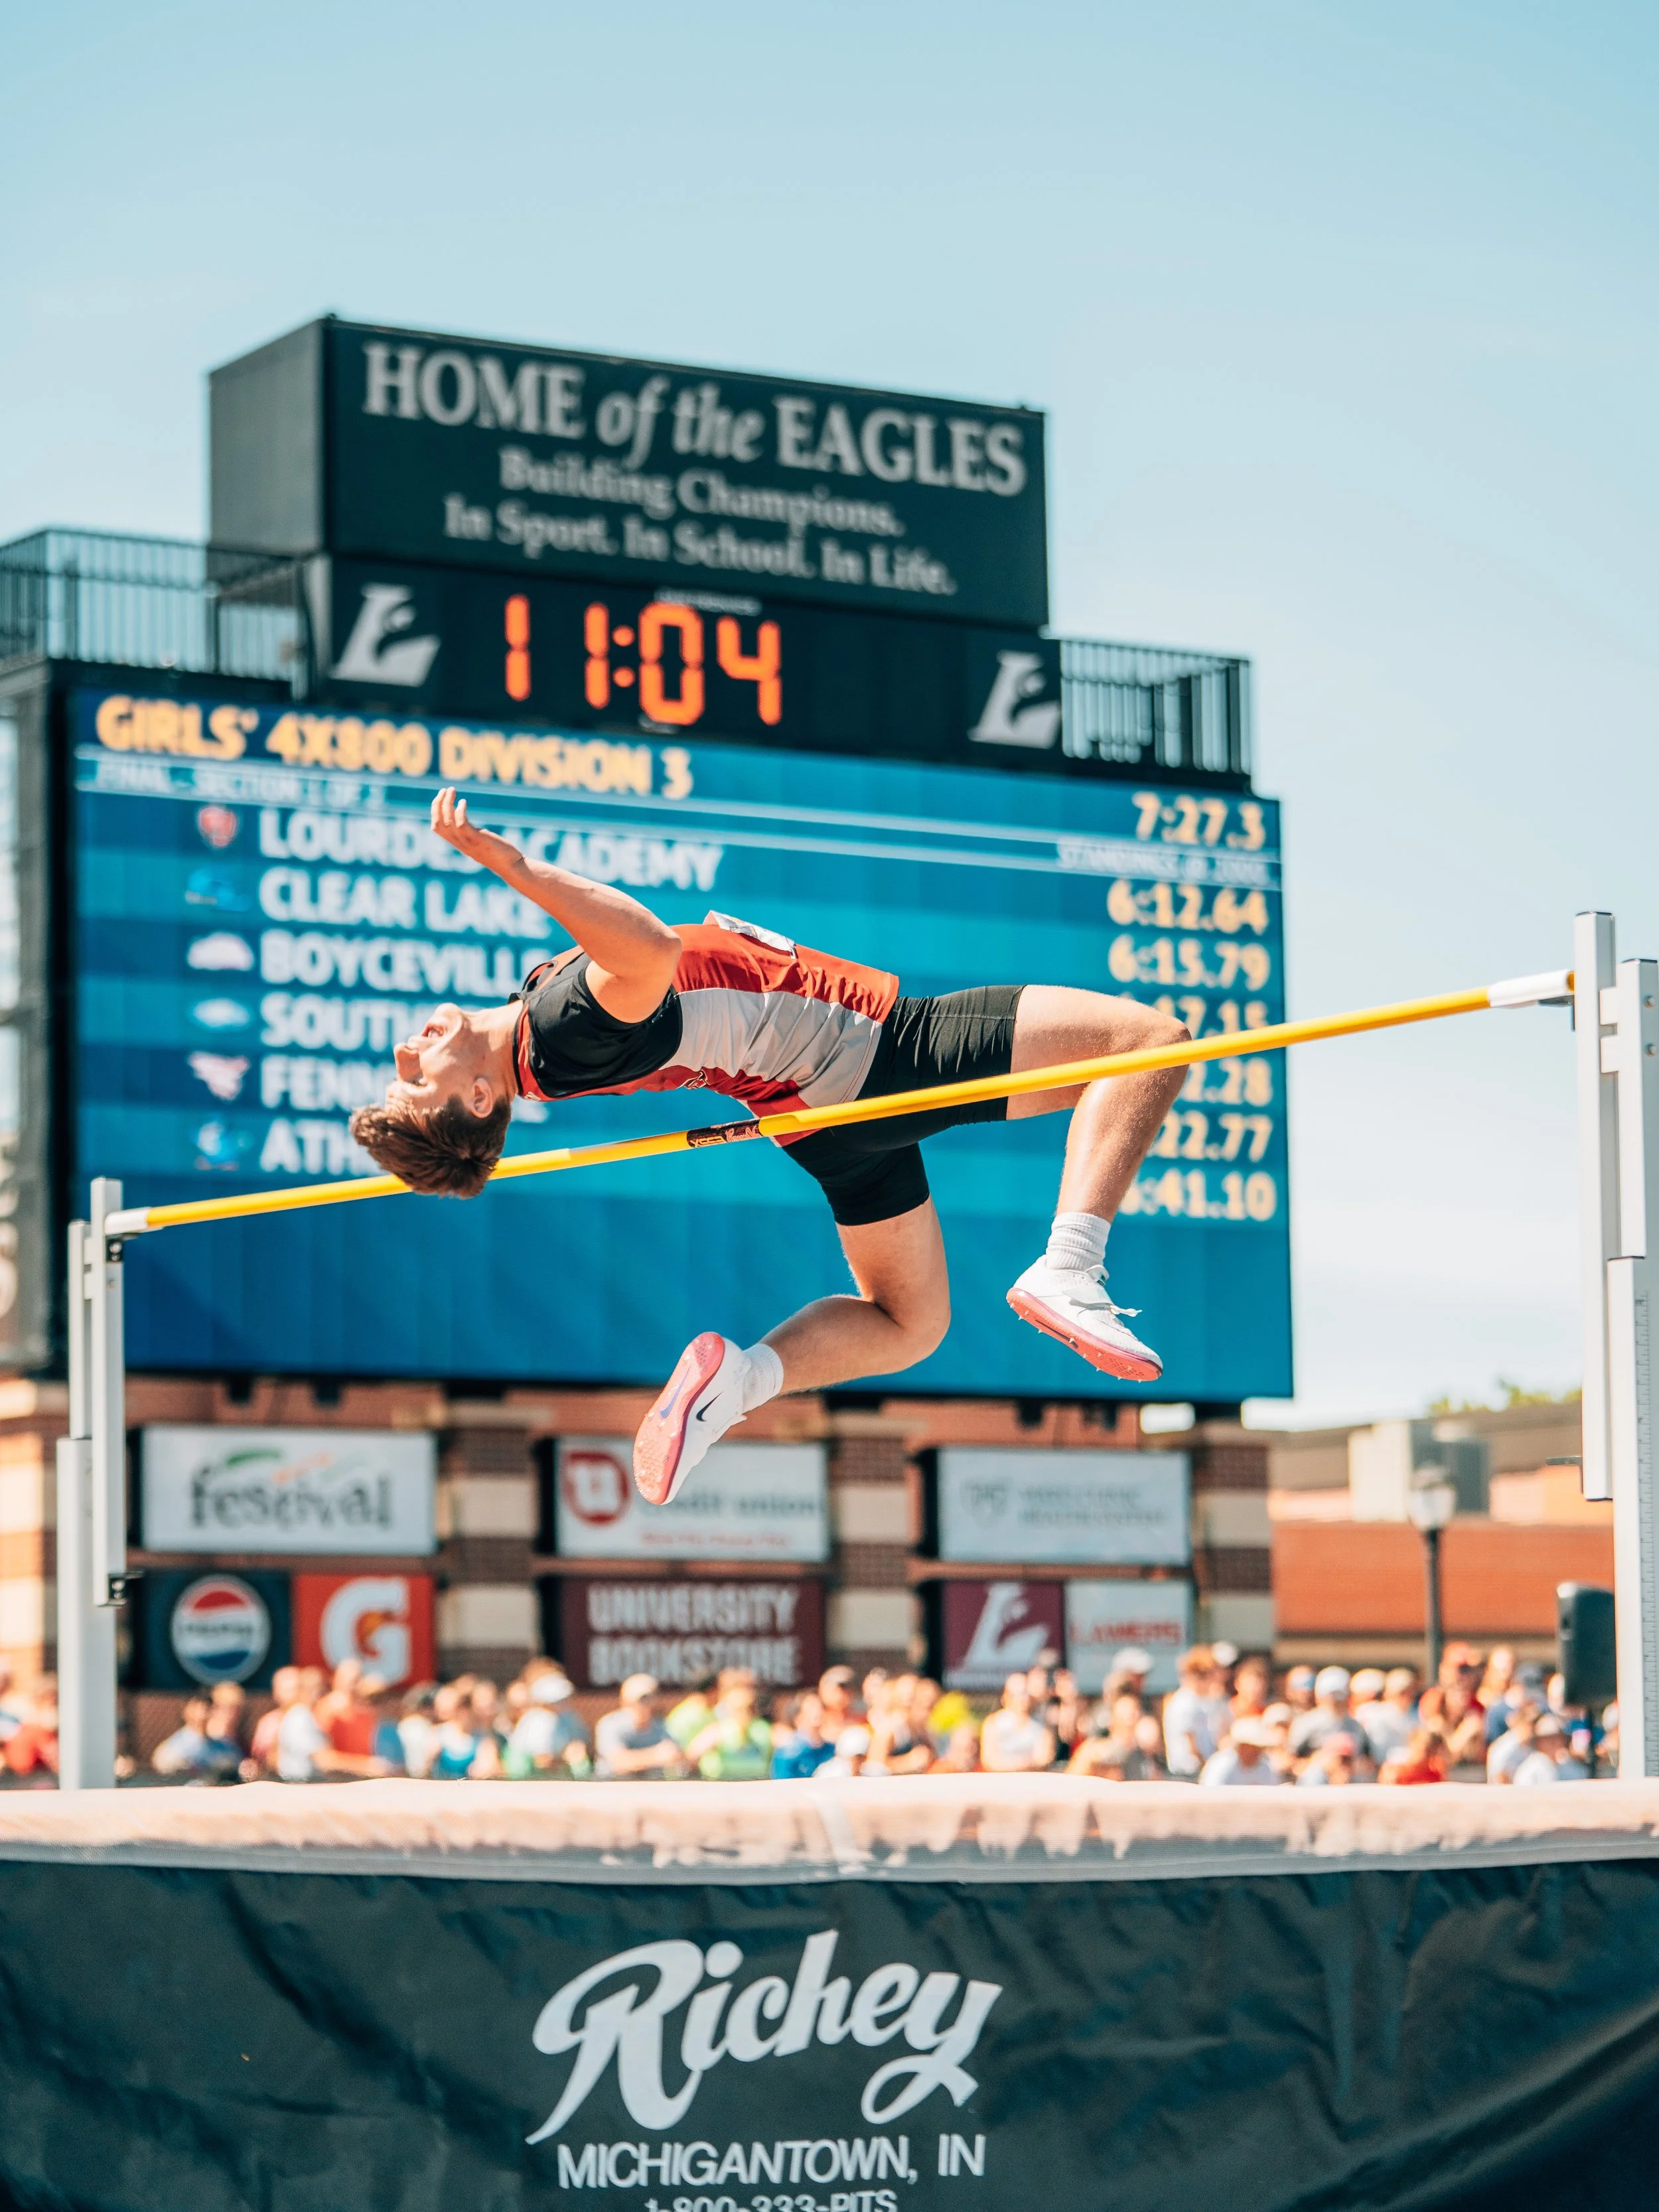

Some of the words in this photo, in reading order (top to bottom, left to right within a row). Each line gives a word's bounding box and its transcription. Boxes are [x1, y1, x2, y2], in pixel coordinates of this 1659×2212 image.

[362, 340, 585, 439] HOME
[596, 374, 670, 471] of
[672, 381, 764, 464] the
[772, 395, 1027, 497] EAGLES
[499, 444, 676, 520] Building
[676, 466, 906, 537] Champions.
[443, 492, 492, 541] In
[496, 498, 618, 559] Sport.
[622, 514, 670, 562] In
[674, 520, 817, 580] School.
[820, 536, 863, 585] In
[869, 541, 958, 596] Life.
[96, 694, 259, 762] GIRLS'
[266, 711, 433, 778] 4X800
[438, 726, 652, 797] DIVISION
[660, 746, 694, 801] 3
[1131, 791, 1265, 851] 7:27.3
[259, 866, 417, 929] CLEAR
[426, 880, 552, 939] LAKE
[1107, 878, 1269, 935] 6:12.64
[1108, 934, 1271, 992] 6:15.79
[587, 1581, 799, 1632] UNIVERSITY
[525, 1929, 1003, 2144] Richey
[557, 2136, 918, 2189] MICHIGANTOWN,
[938, 2133, 986, 2176] IN
